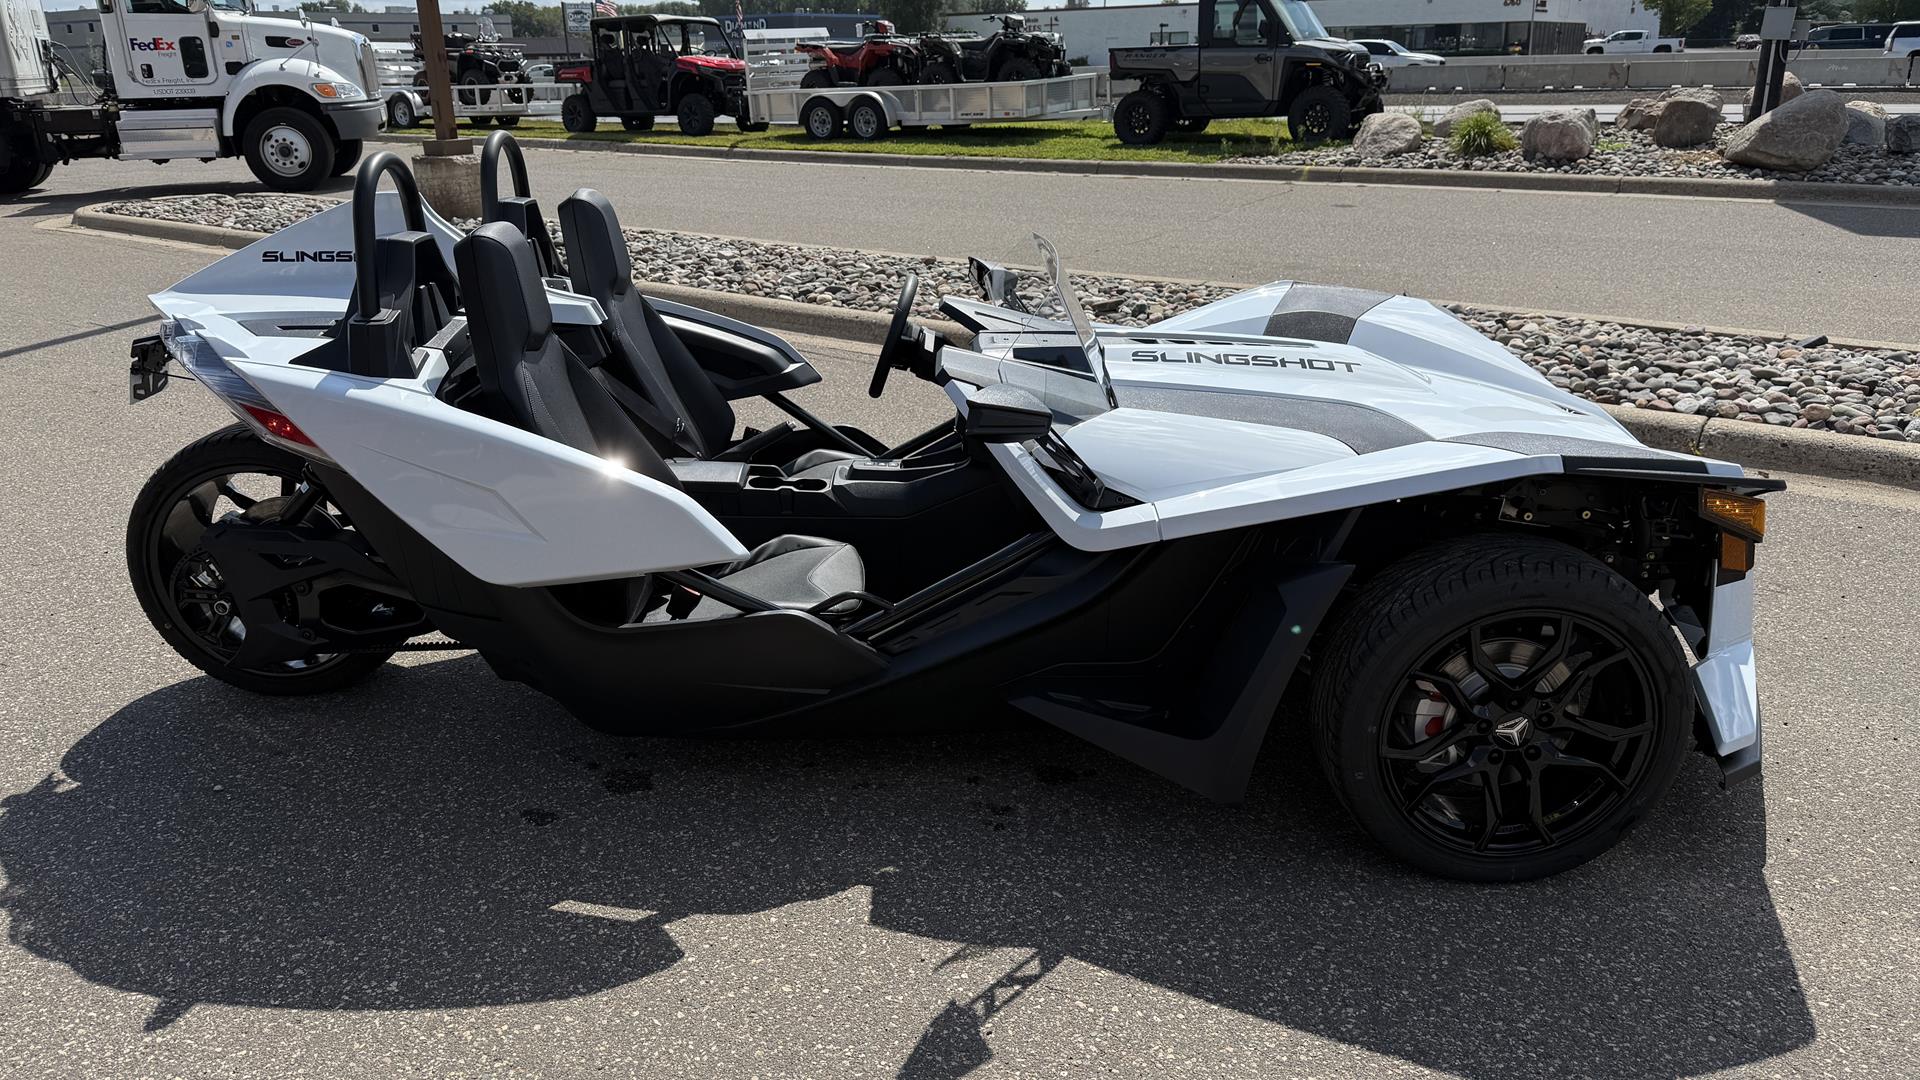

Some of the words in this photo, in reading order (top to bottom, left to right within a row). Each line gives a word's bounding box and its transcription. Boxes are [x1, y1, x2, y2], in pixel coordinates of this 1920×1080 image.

[129, 37, 176, 51] FedEx
[262, 250, 357, 262] SLINGS
[1131, 350, 1361, 373] SLINGSHOT
